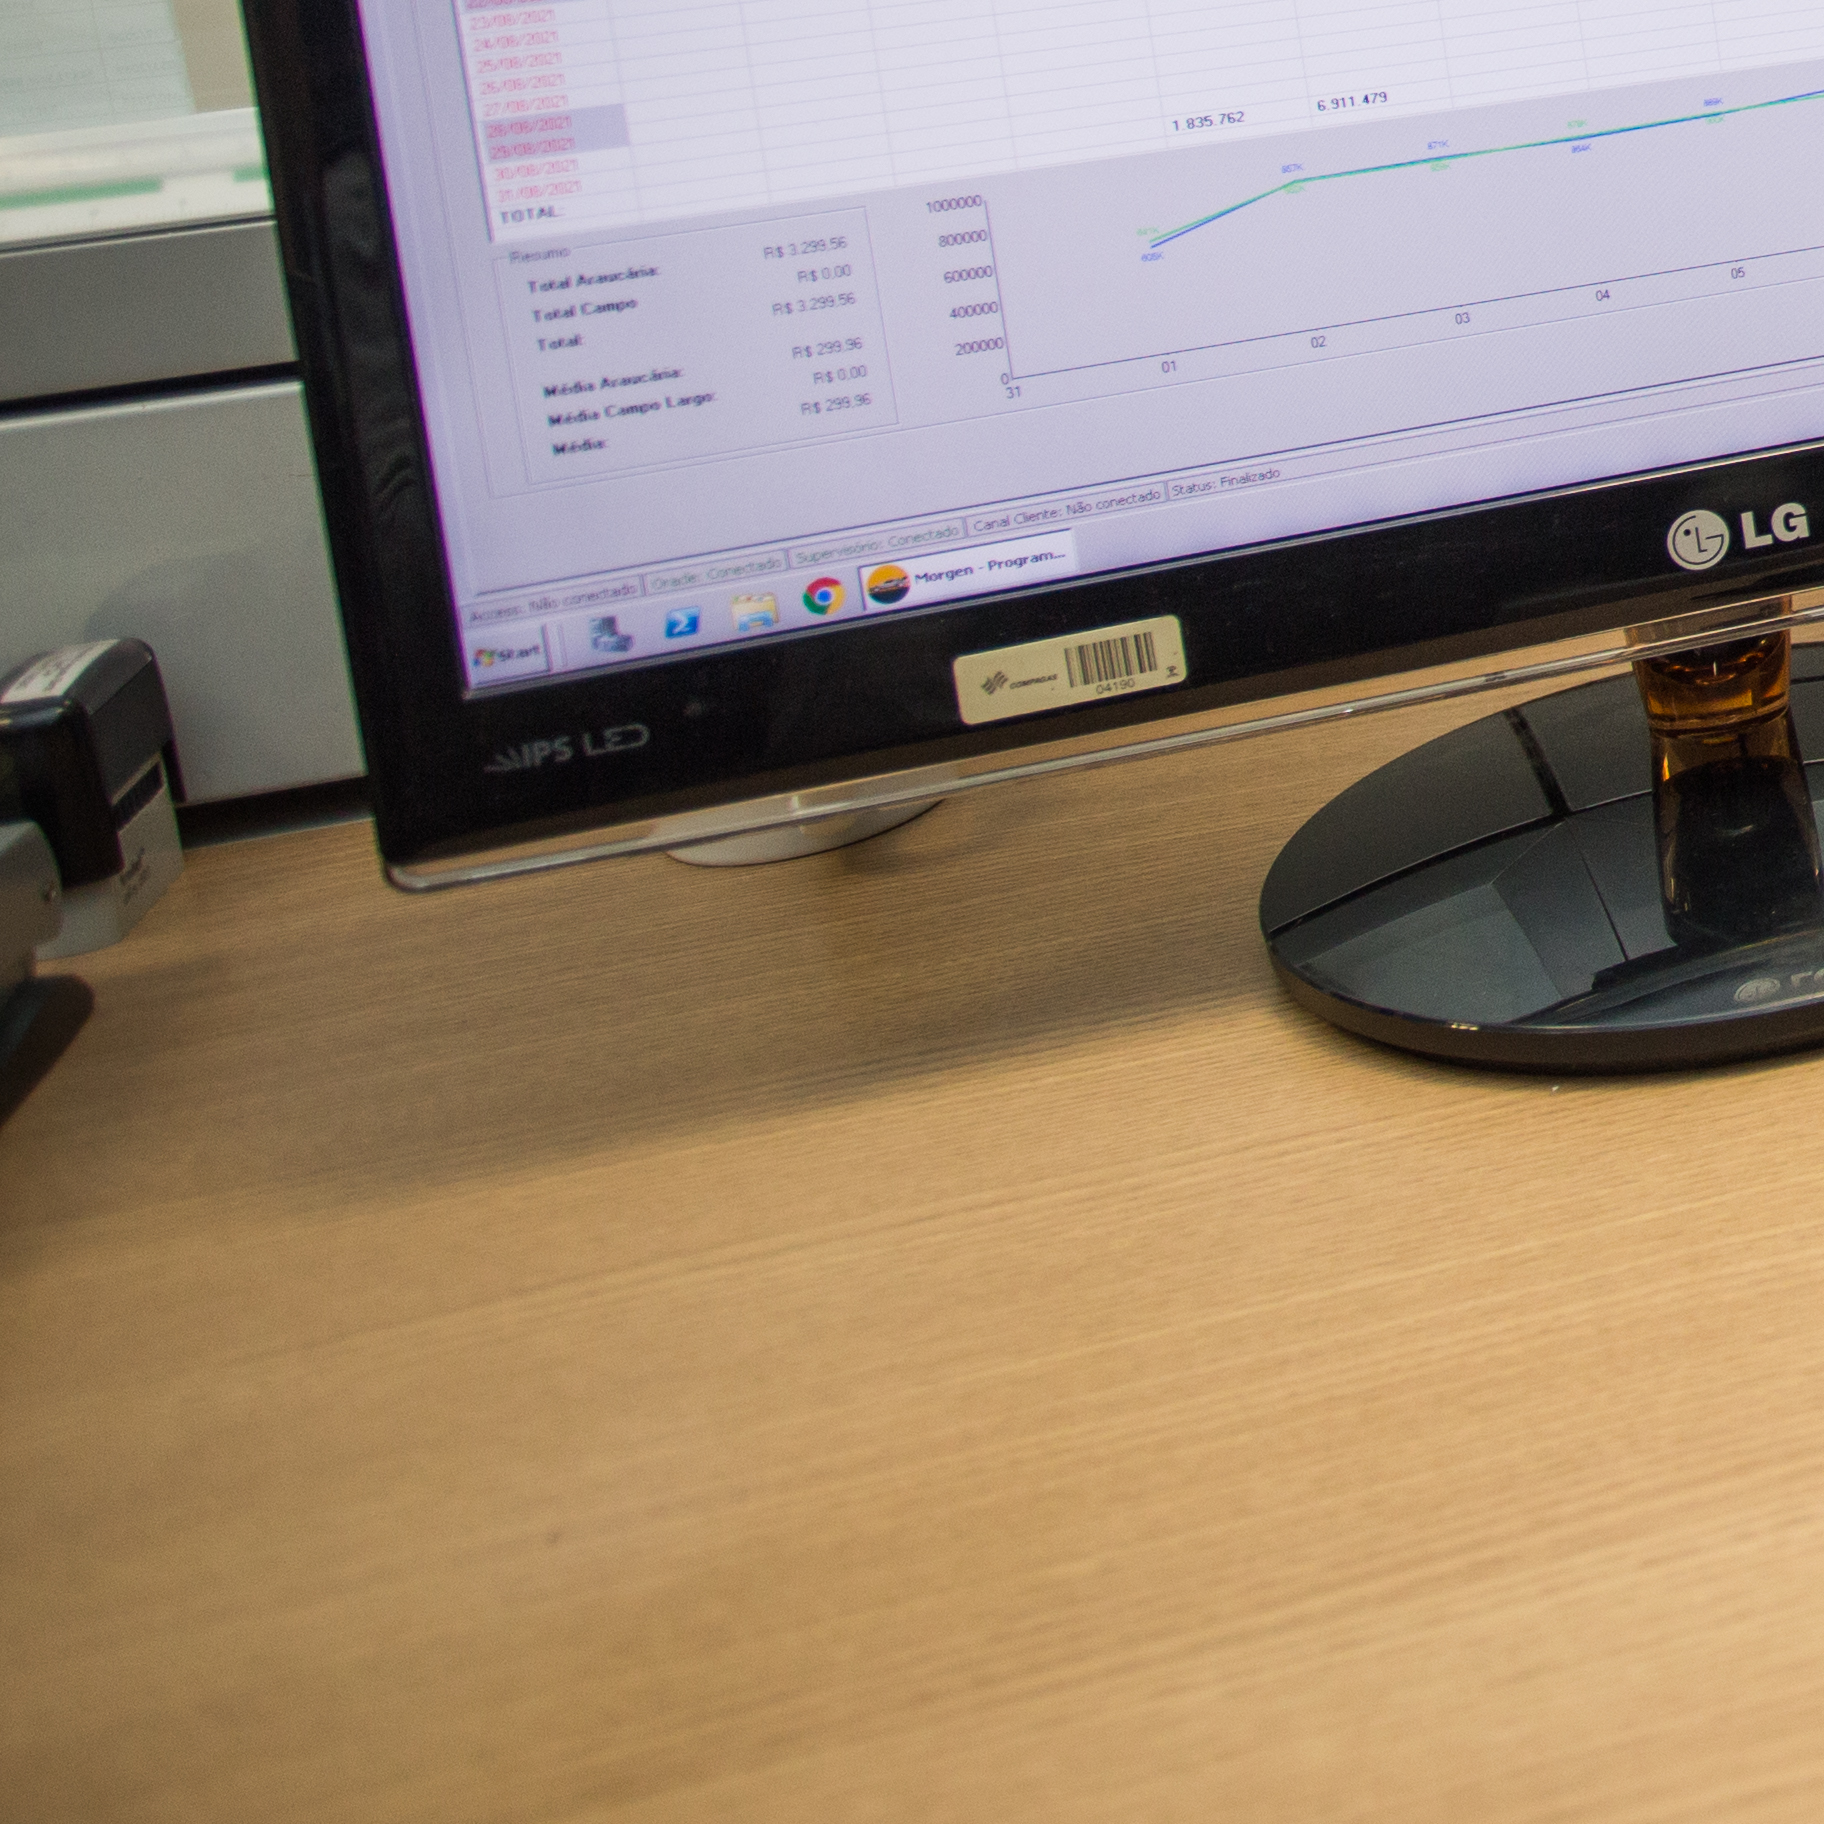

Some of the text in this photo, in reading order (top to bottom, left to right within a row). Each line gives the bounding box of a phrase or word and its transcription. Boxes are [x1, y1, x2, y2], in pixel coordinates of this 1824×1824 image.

[1317, 92, 1388, 112] 6.911.479
[1172, 111, 1245, 131] 1.835.762
[1455, 312, 1470, 325] 03
[1162, 360, 1177, 373] 01
[1171, 467, 1280, 498] Status: Finalizado
[973, 488, 1160, 533] Canal Cliente: Não conectado
[1740, 502, 1810, 550] LG
[1096, 677, 1135, 694] 04190
